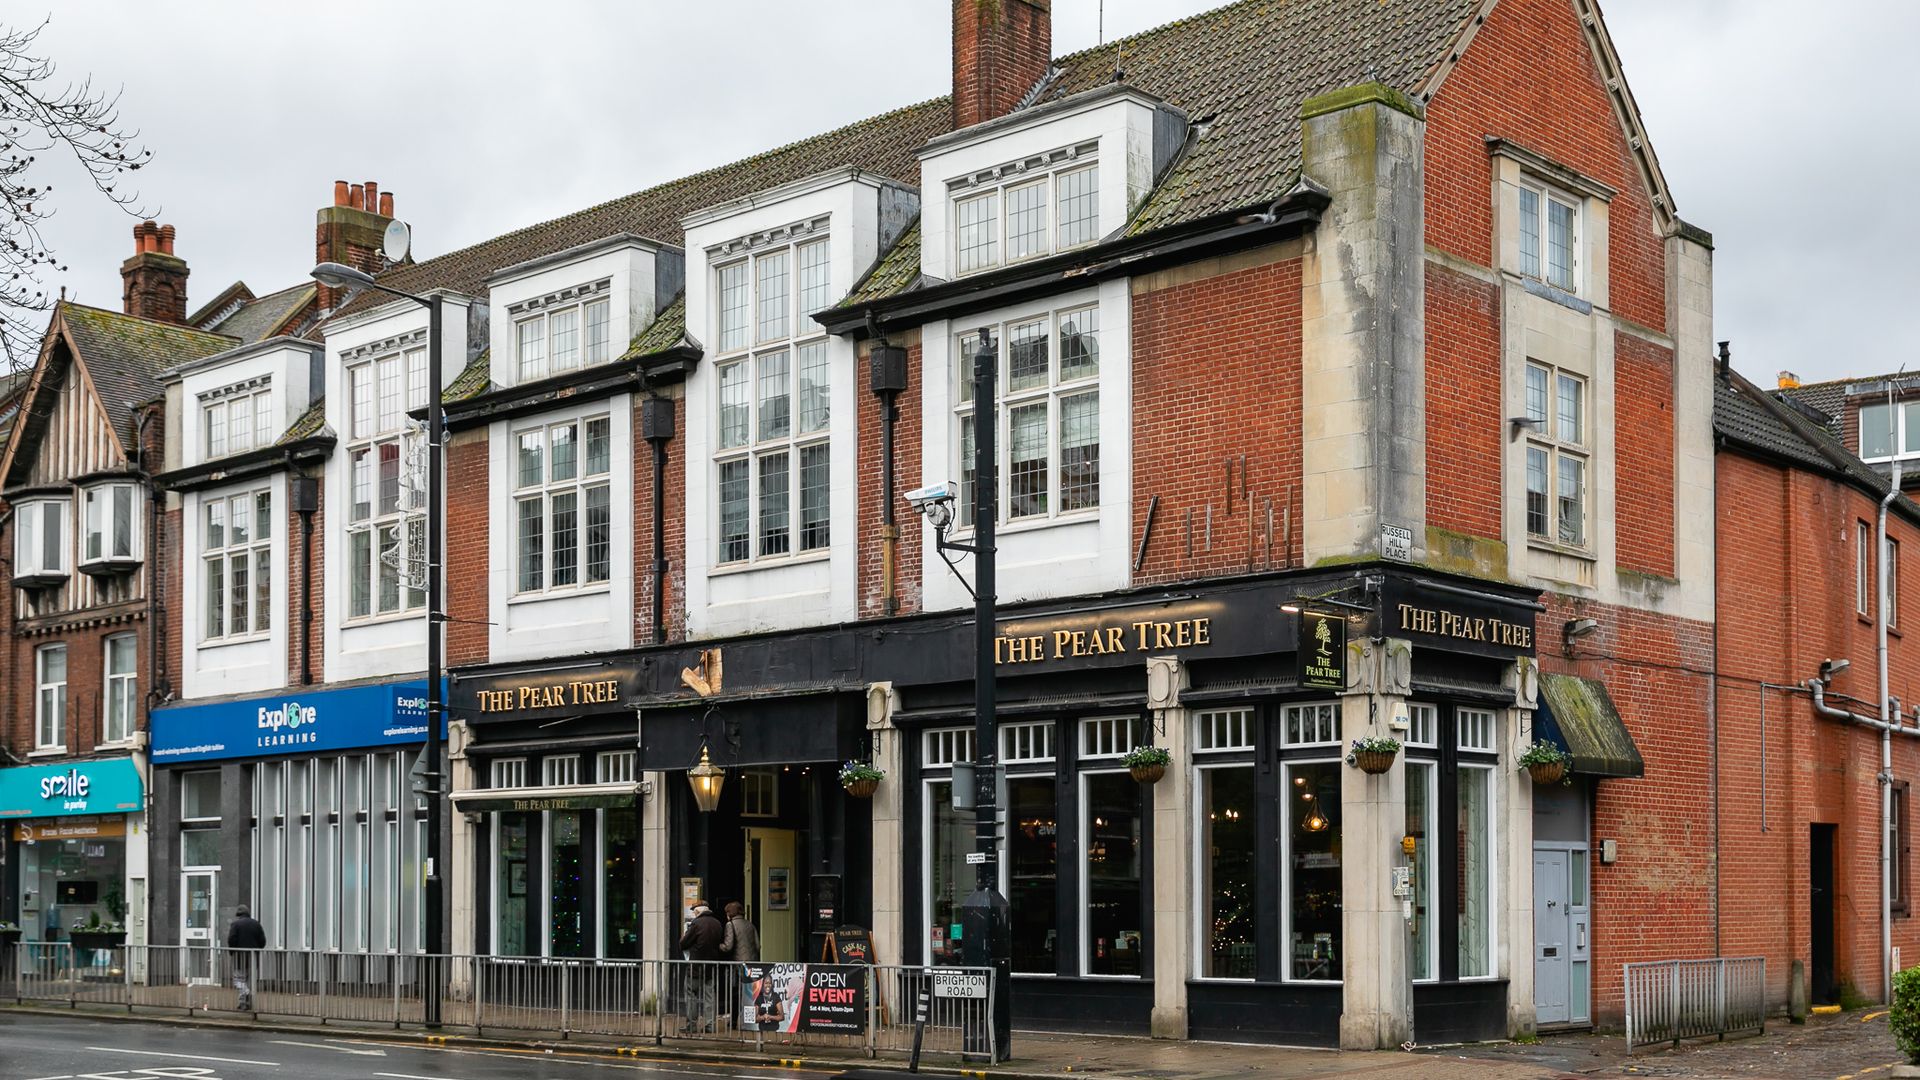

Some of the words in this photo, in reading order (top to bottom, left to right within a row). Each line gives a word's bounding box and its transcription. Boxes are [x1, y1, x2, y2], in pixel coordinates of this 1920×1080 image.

[1383, 525, 1410, 540] RUSSELL
[1389, 539, 1403, 549] HILL
[1386, 548, 1407, 560] PLACE
[1398, 603, 1437, 634] THE
[1440, 610, 1486, 641] PEAR
[1489, 618, 1531, 648] TREE
[1053, 627, 1126, 659] PEAR
[1132, 618, 1210, 650] TREE
[1316, 656, 1331, 667] THE
[1306, 665, 1323, 676] PEAR
[1324, 667, 1341, 678] TREE
[477, 690, 513, 713] THE
[518, 686, 565, 709] PEAR
[569, 680, 618, 704] TREE
[258, 702, 316, 731] Explore
[258, 732, 317, 747] LEARNING
[41, 768, 89, 799] smile
[514, 800, 529, 810] THE
[530, 799, 550, 810] PEAR
[551, 799, 569, 808] TREE
[810, 972, 846, 987] OPEN
[936, 976, 985, 986] BRIGHTON
[809, 988, 855, 1003] EVENT
[947, 986, 973, 996] ROAD
